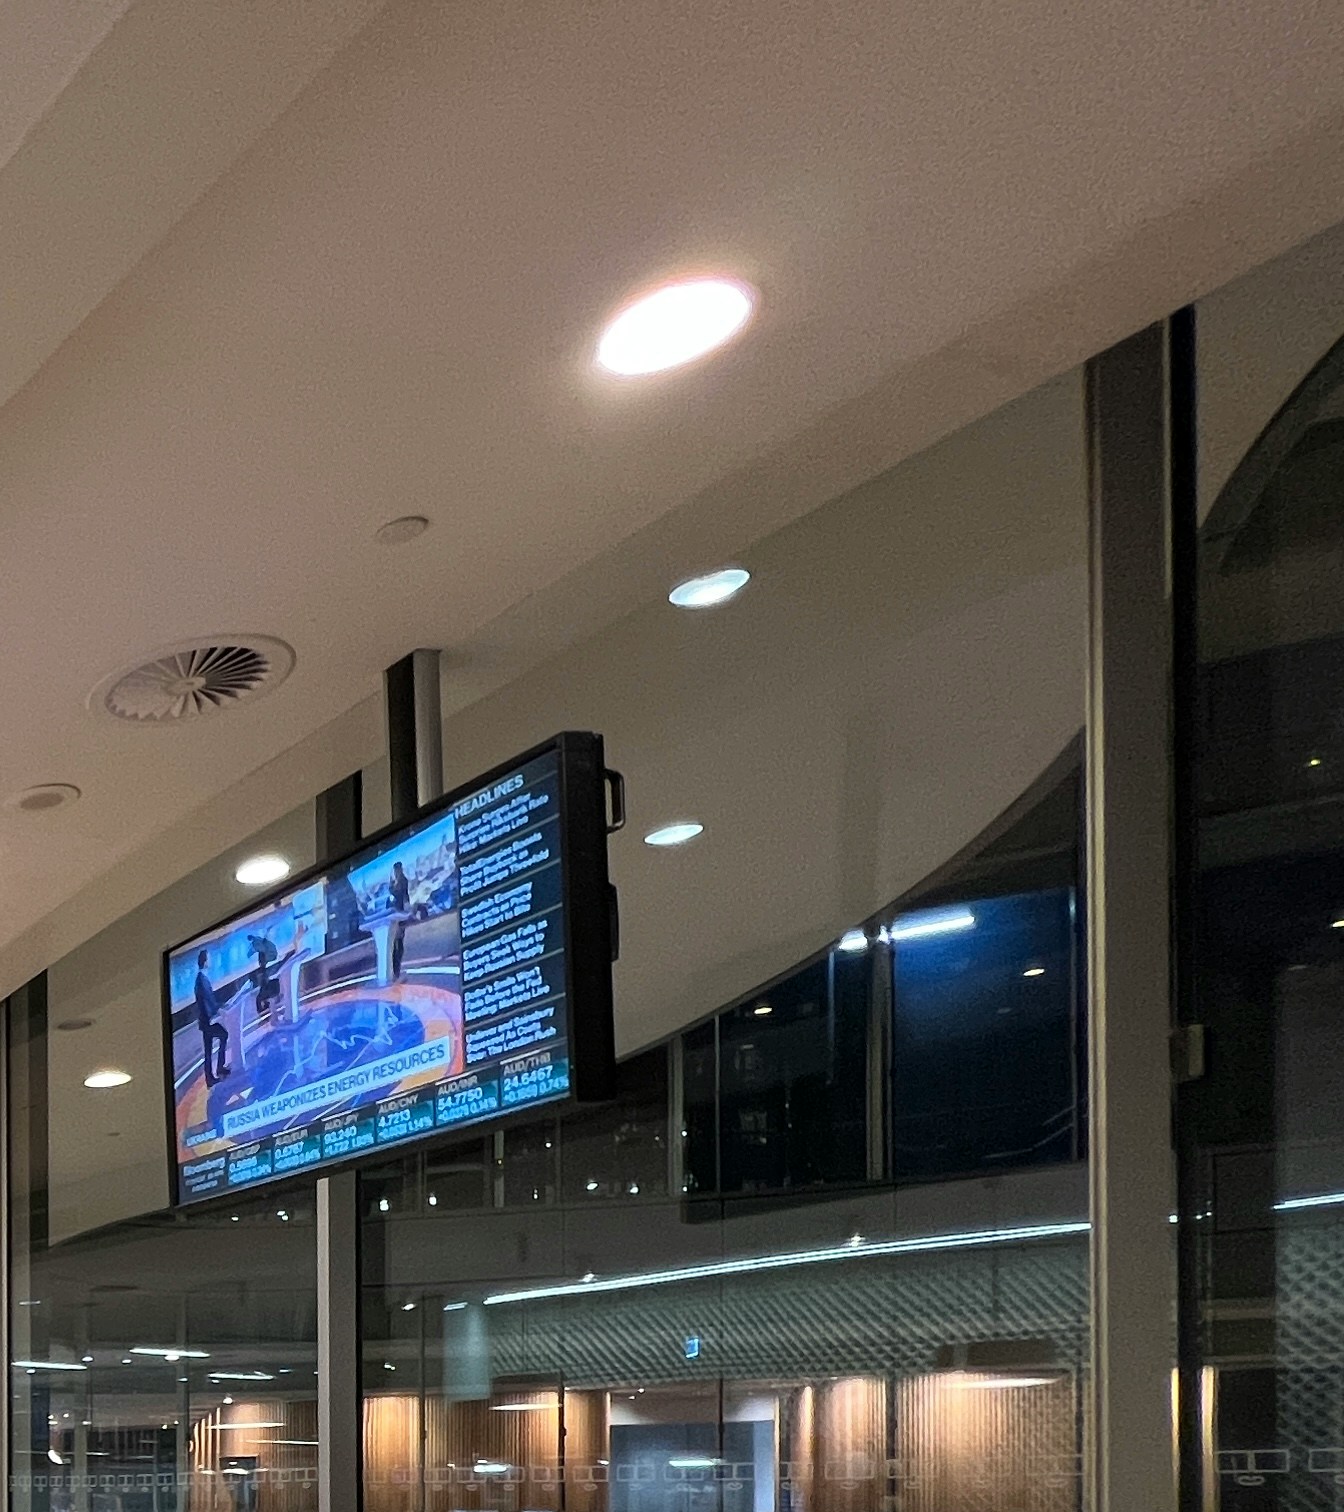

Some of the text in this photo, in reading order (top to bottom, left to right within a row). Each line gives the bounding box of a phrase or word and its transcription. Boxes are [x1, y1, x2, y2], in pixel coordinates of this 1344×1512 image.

[455, 774, 524, 819] HEADLINES
[512, 815, 529, 829] Live
[532, 985, 550, 998] Live
[503, 1052, 551, 1076] AUD/THB
[227, 1044, 445, 1130] RUSSIA WEAPONIZES ENERGY RESOURCES
[504, 1065, 553, 1092] 24.6467
[378, 1094, 419, 1114] AUD/CNY
